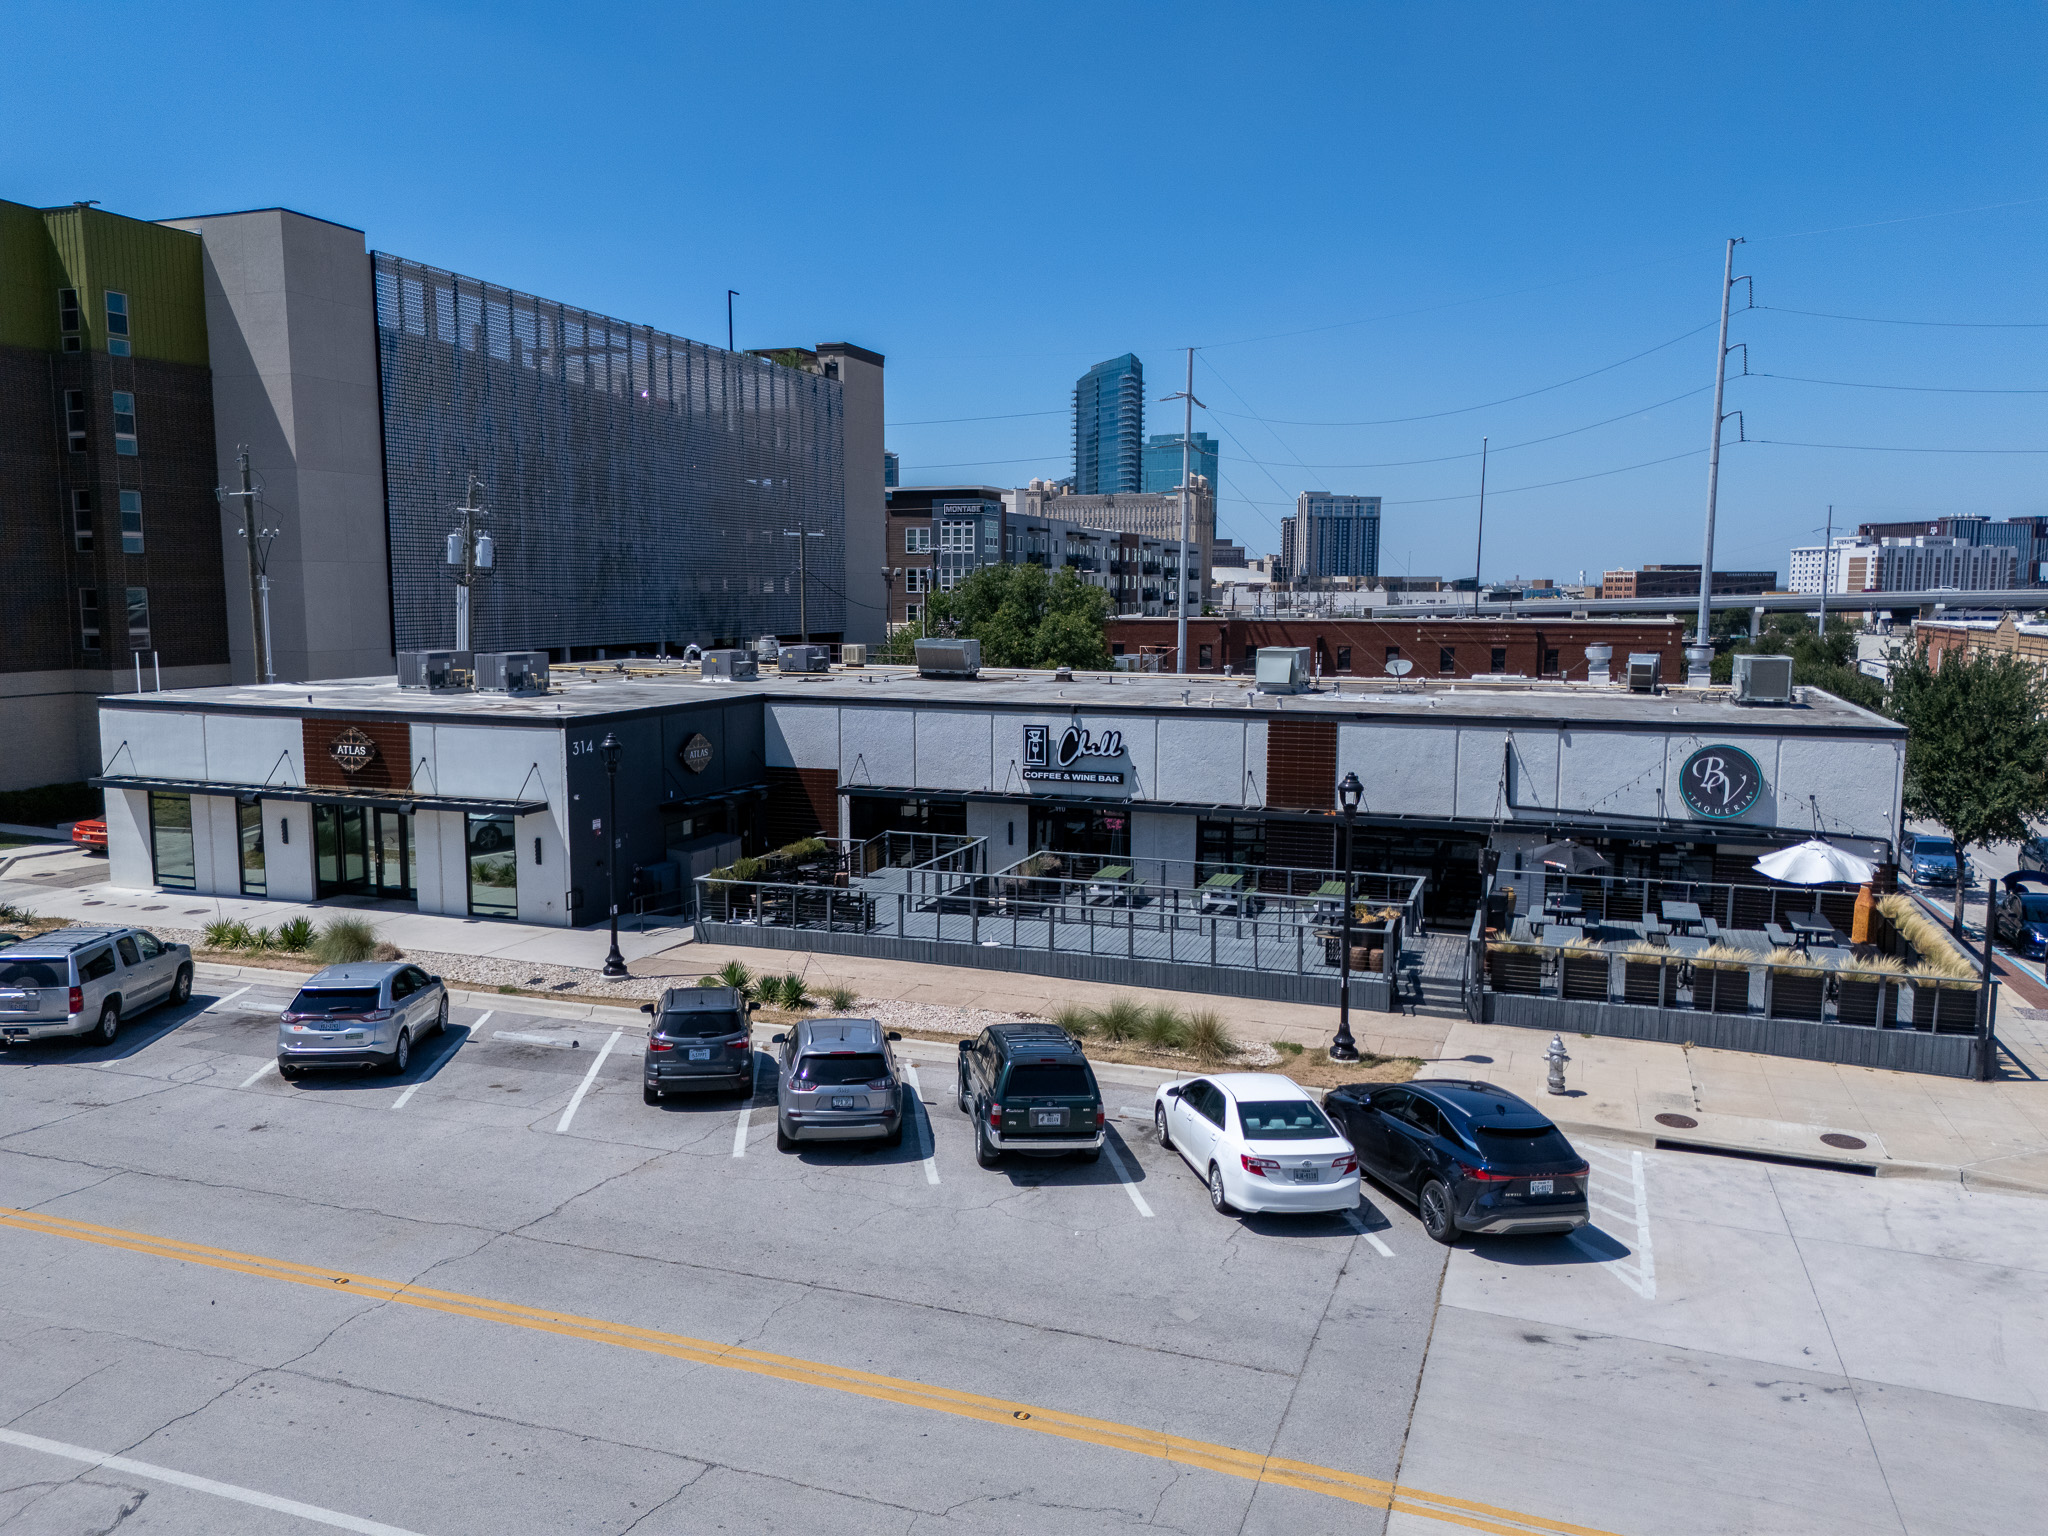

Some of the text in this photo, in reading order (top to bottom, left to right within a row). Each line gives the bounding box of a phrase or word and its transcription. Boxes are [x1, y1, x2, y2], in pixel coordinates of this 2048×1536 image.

[945, 505, 981, 513] MONTAGE
[337, 745, 366, 756] ATLAS
[572, 740, 594, 756] 314
[1057, 726, 1124, 767] Chill
[689, 748, 709, 759] ATLAS
[1024, 771, 1062, 780] COFFEE
[1072, 773, 1096, 782] WINE
[1098, 775, 1120, 783] BAR
[1690, 795, 1753, 815] TAQUERIA
